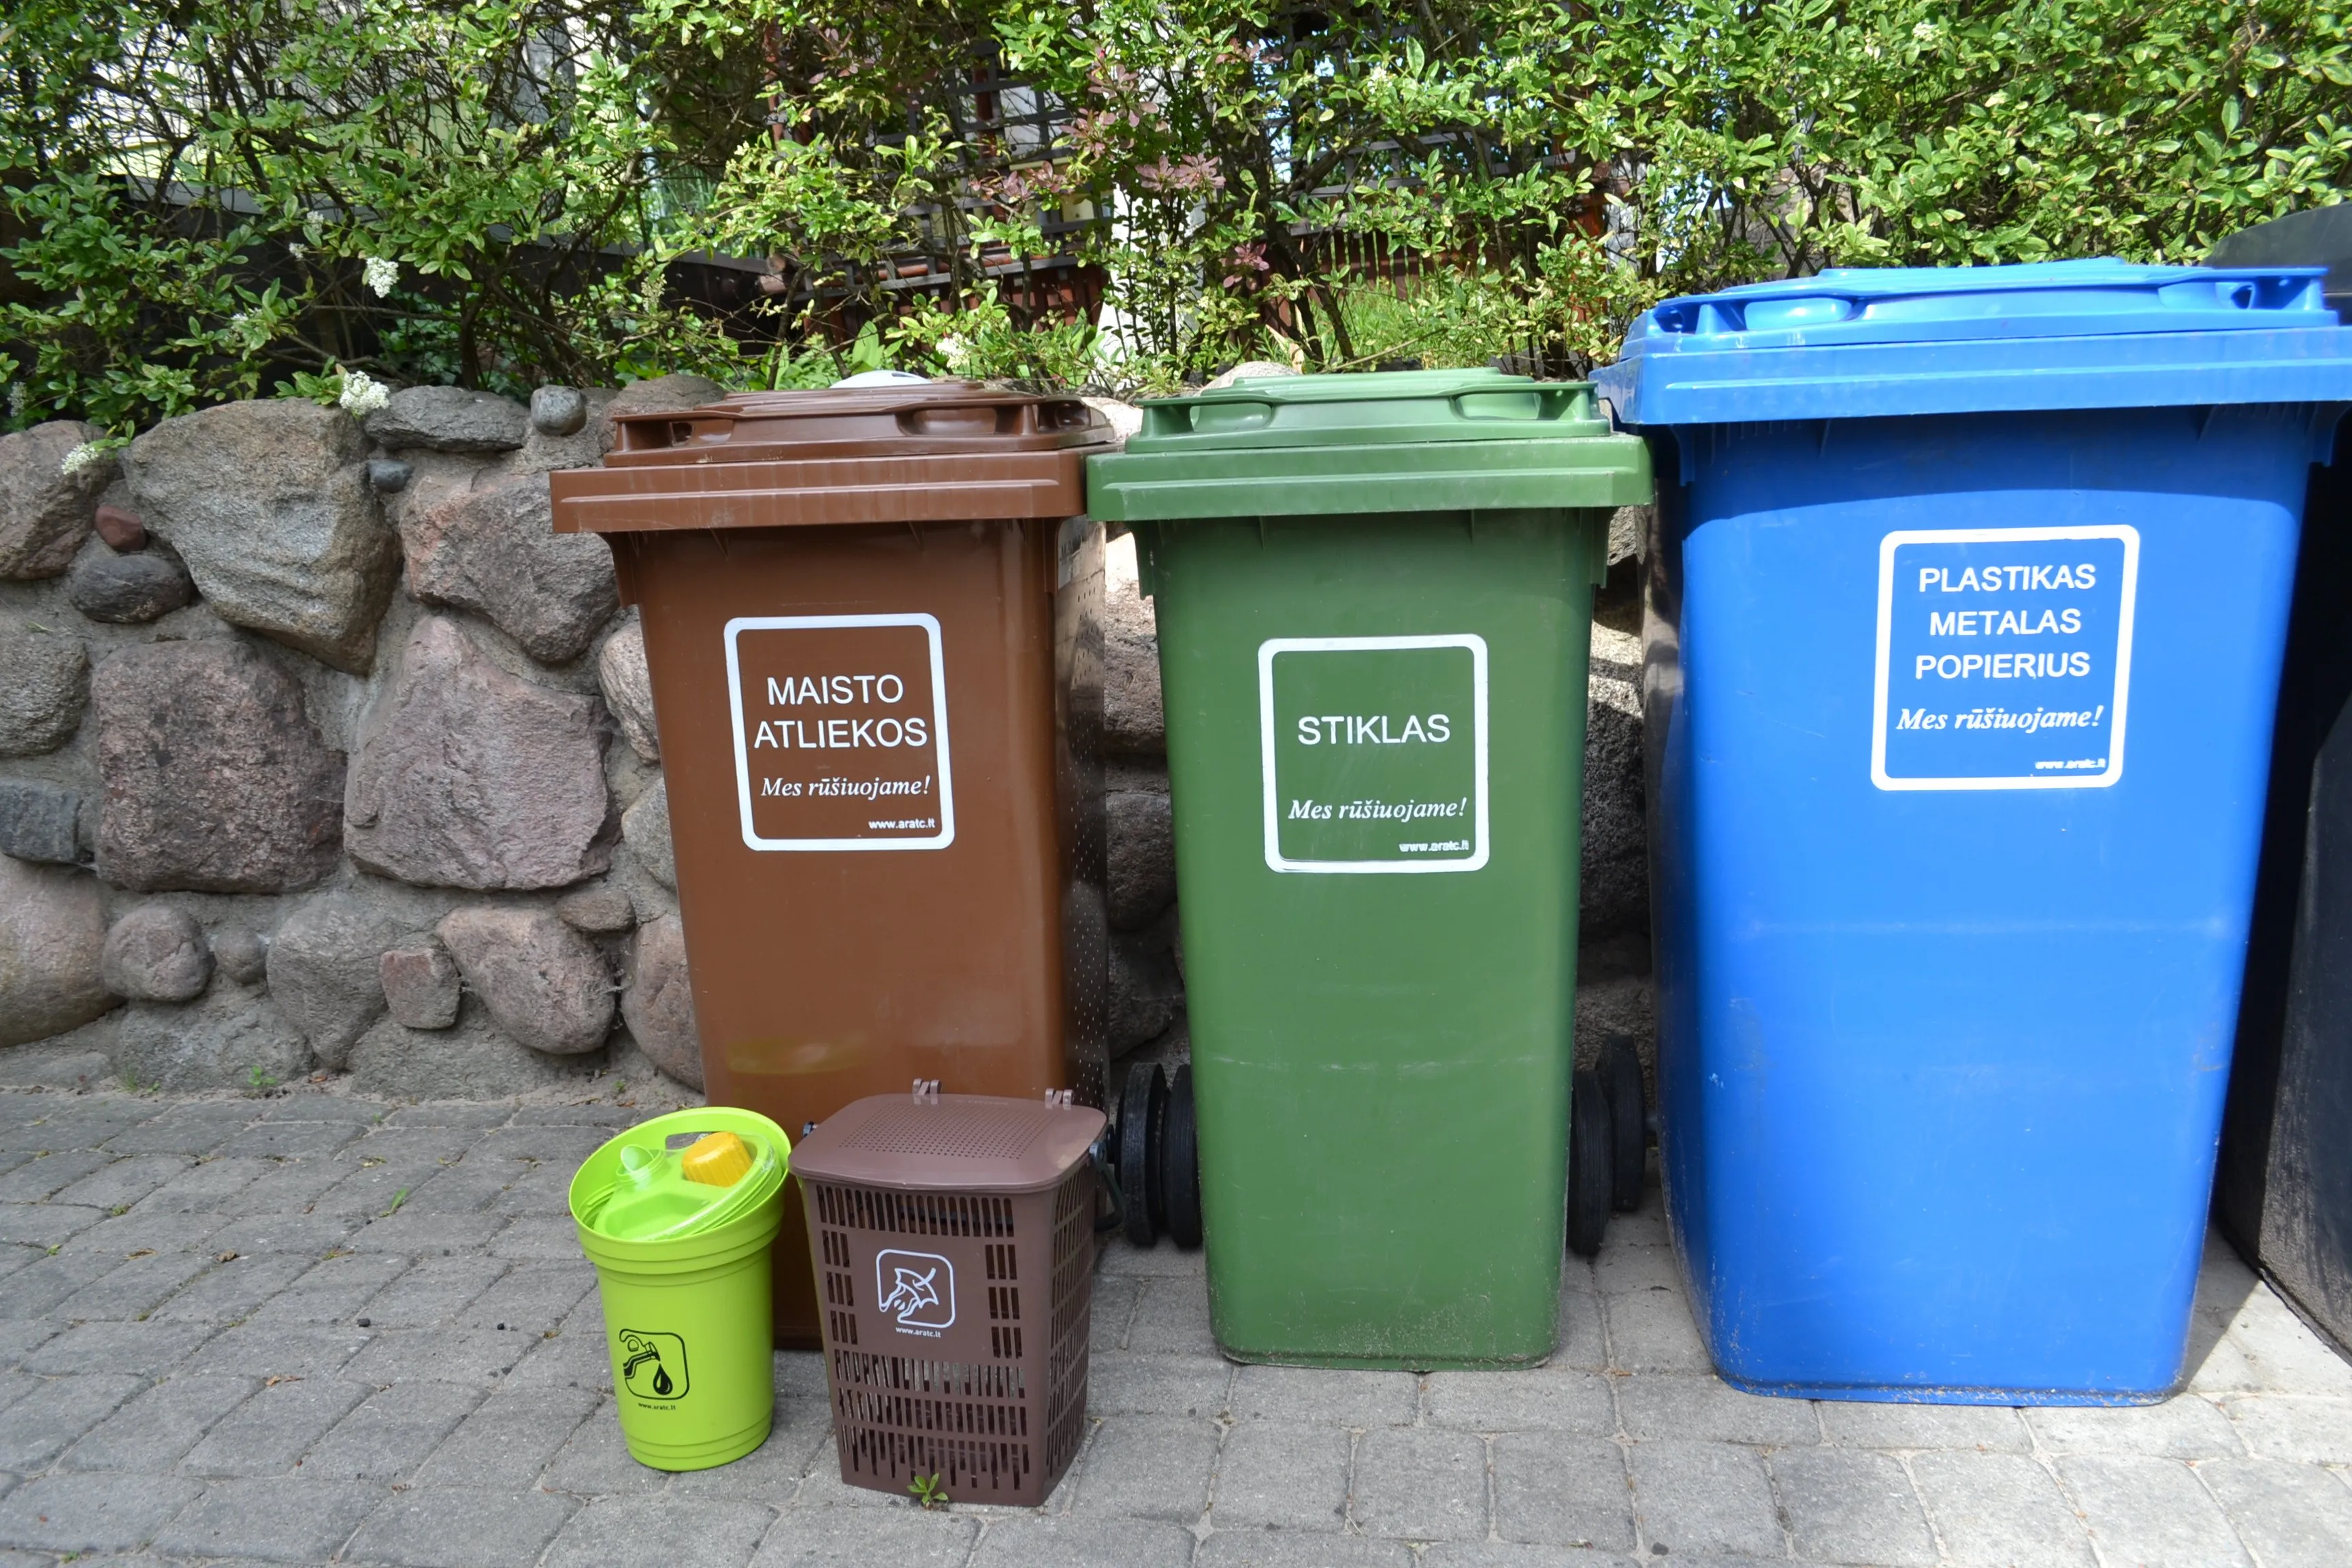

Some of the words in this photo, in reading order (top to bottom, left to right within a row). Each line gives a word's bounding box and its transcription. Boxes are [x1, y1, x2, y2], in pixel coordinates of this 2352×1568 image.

[1920, 564, 2095, 592] PLASTIKAS
[1930, 608, 2080, 636] METALAS
[1916, 652, 2089, 679] POPIERIUS
[768, 674, 903, 705] MAISTO
[754, 718, 927, 748] ATLIEKOS
[1298, 715, 1450, 745] STIKLAS
[1897, 708, 1948, 729] Mes
[1955, 705, 2104, 733] rūšiuojame!
[762, 778, 802, 796] Mes
[809, 775, 930, 800] rūšiuojame!
[868, 818, 935, 828] www.aratc.lt
[1288, 800, 1332, 819] Mes
[1339, 798, 1467, 822] rūšiuojame!
[896, 1327, 941, 1337] www.aratc.lt
